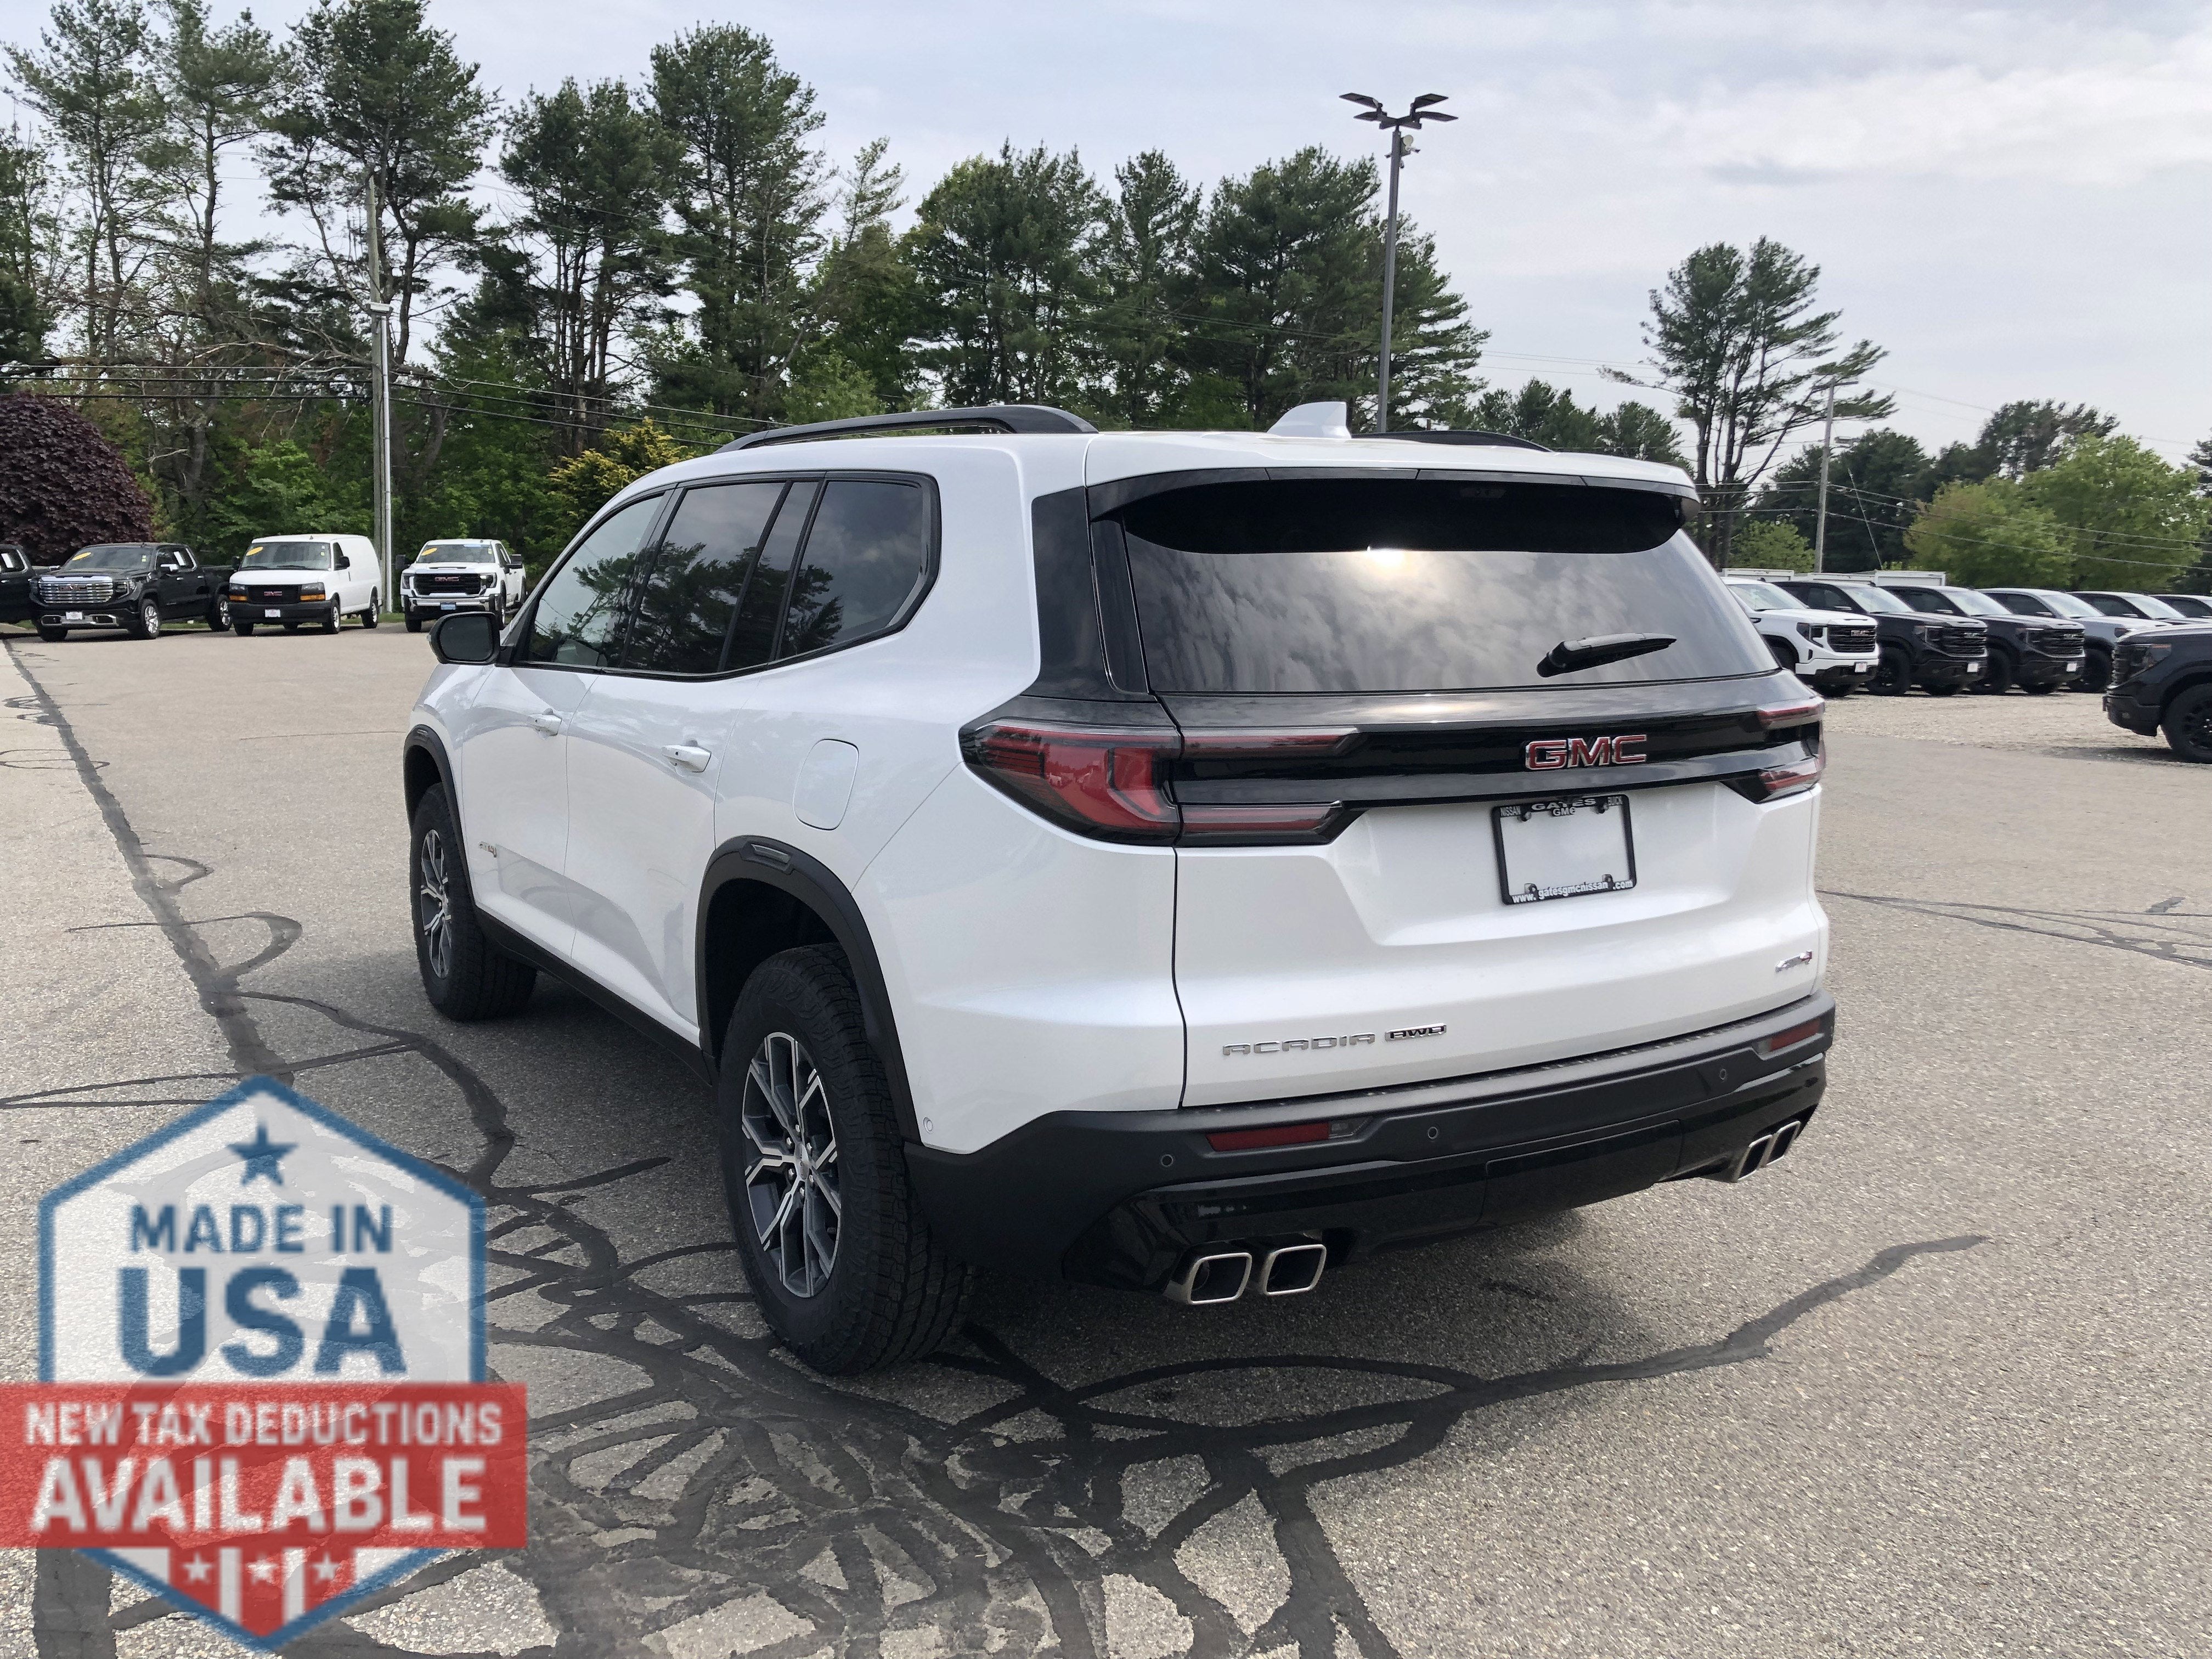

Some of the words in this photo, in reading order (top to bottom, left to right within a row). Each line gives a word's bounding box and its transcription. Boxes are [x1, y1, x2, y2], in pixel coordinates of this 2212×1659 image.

[1525, 734, 1647, 770] GMC
[1500, 805, 1521, 817] NISSAN
[1531, 798, 1596, 811] GATES
[1553, 806, 1576, 816] GMC
[1222, 1032, 1376, 1056] ACADIA
[1388, 1024, 1446, 1040] AWD
